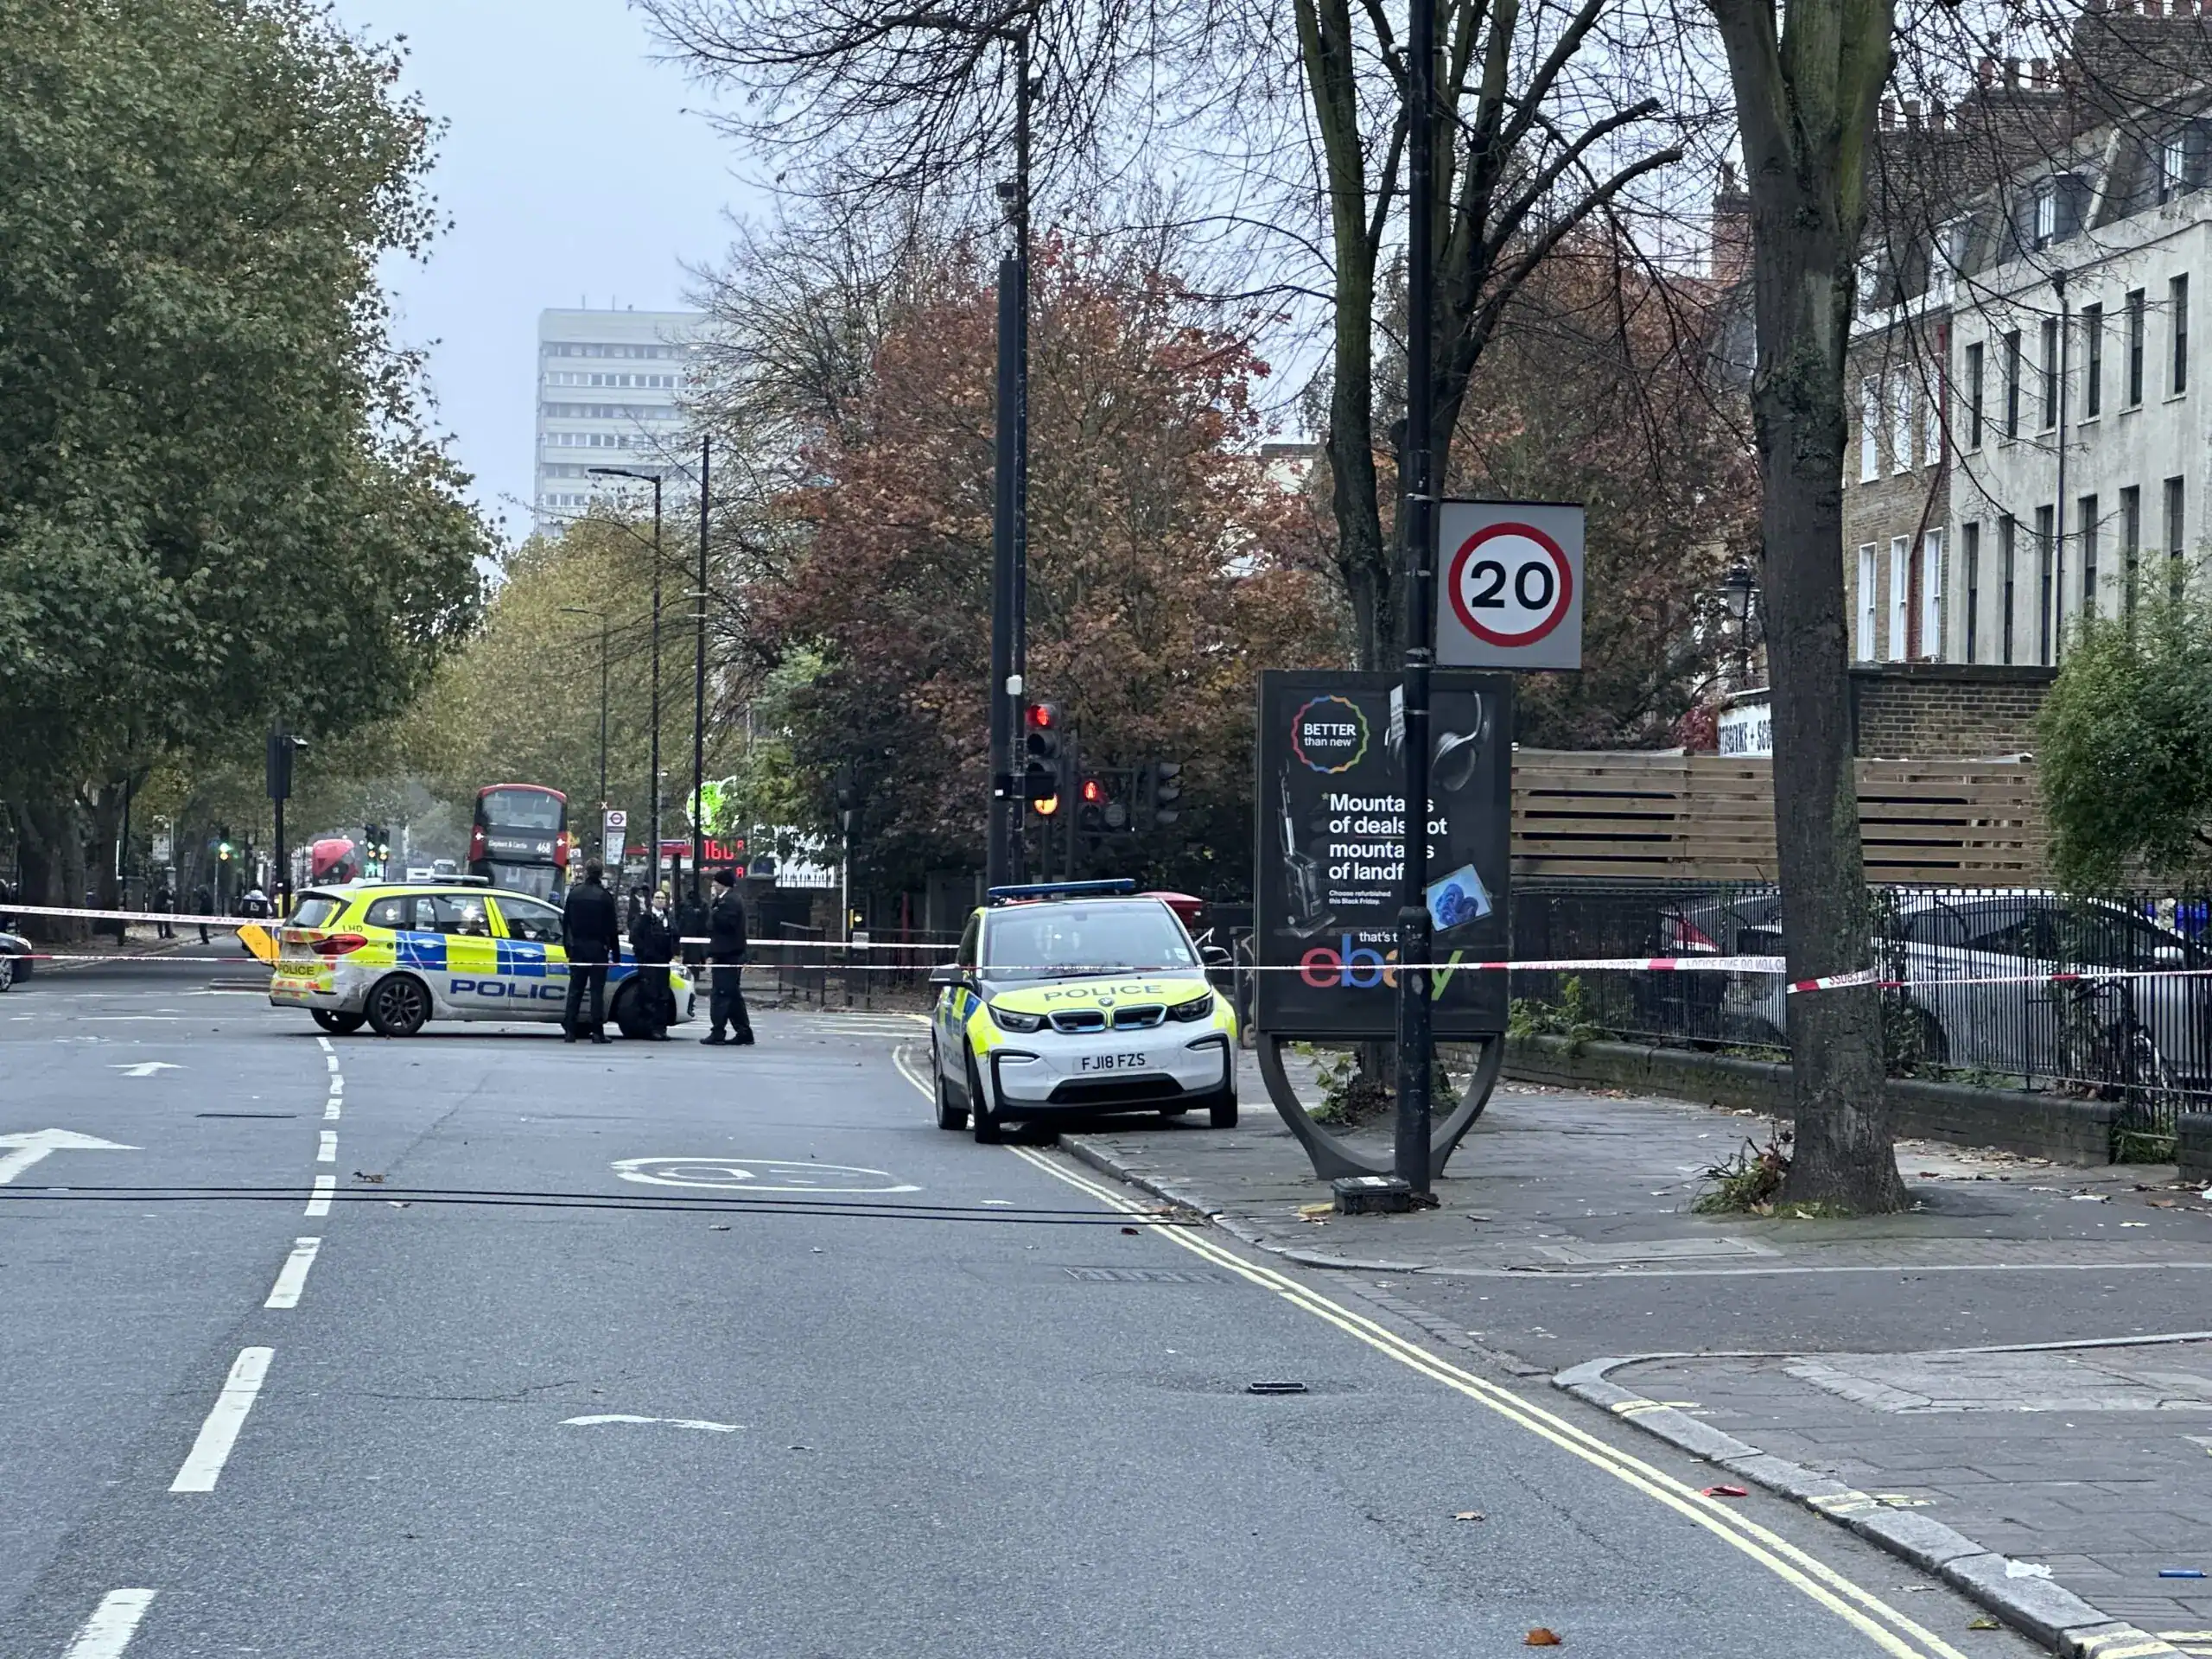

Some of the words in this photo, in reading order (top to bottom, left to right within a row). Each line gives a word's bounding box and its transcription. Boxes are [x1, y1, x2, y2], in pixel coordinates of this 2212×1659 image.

[1471, 560, 1554, 611] 20
[1303, 723, 1357, 736] BETTER
[1304, 736, 1328, 747] than
[1330, 793, 1434, 813] Mountas
[1329, 815, 1351, 834] of
[1427, 817, 1448, 835] ot
[536, 842, 551, 854] 468
[1329, 841, 1435, 859] mountas
[1329, 861, 1351, 880] of
[1354, 862, 1406, 880] landf
[342, 924, 364, 933] LHD
[1359, 931, 1390, 943] that's
[277, 963, 315, 976] POLICE
[1043, 984, 1166, 1002] POLICE
[1081, 1055, 1114, 1071] FJ18
[1117, 1052, 1147, 1068] FZS
